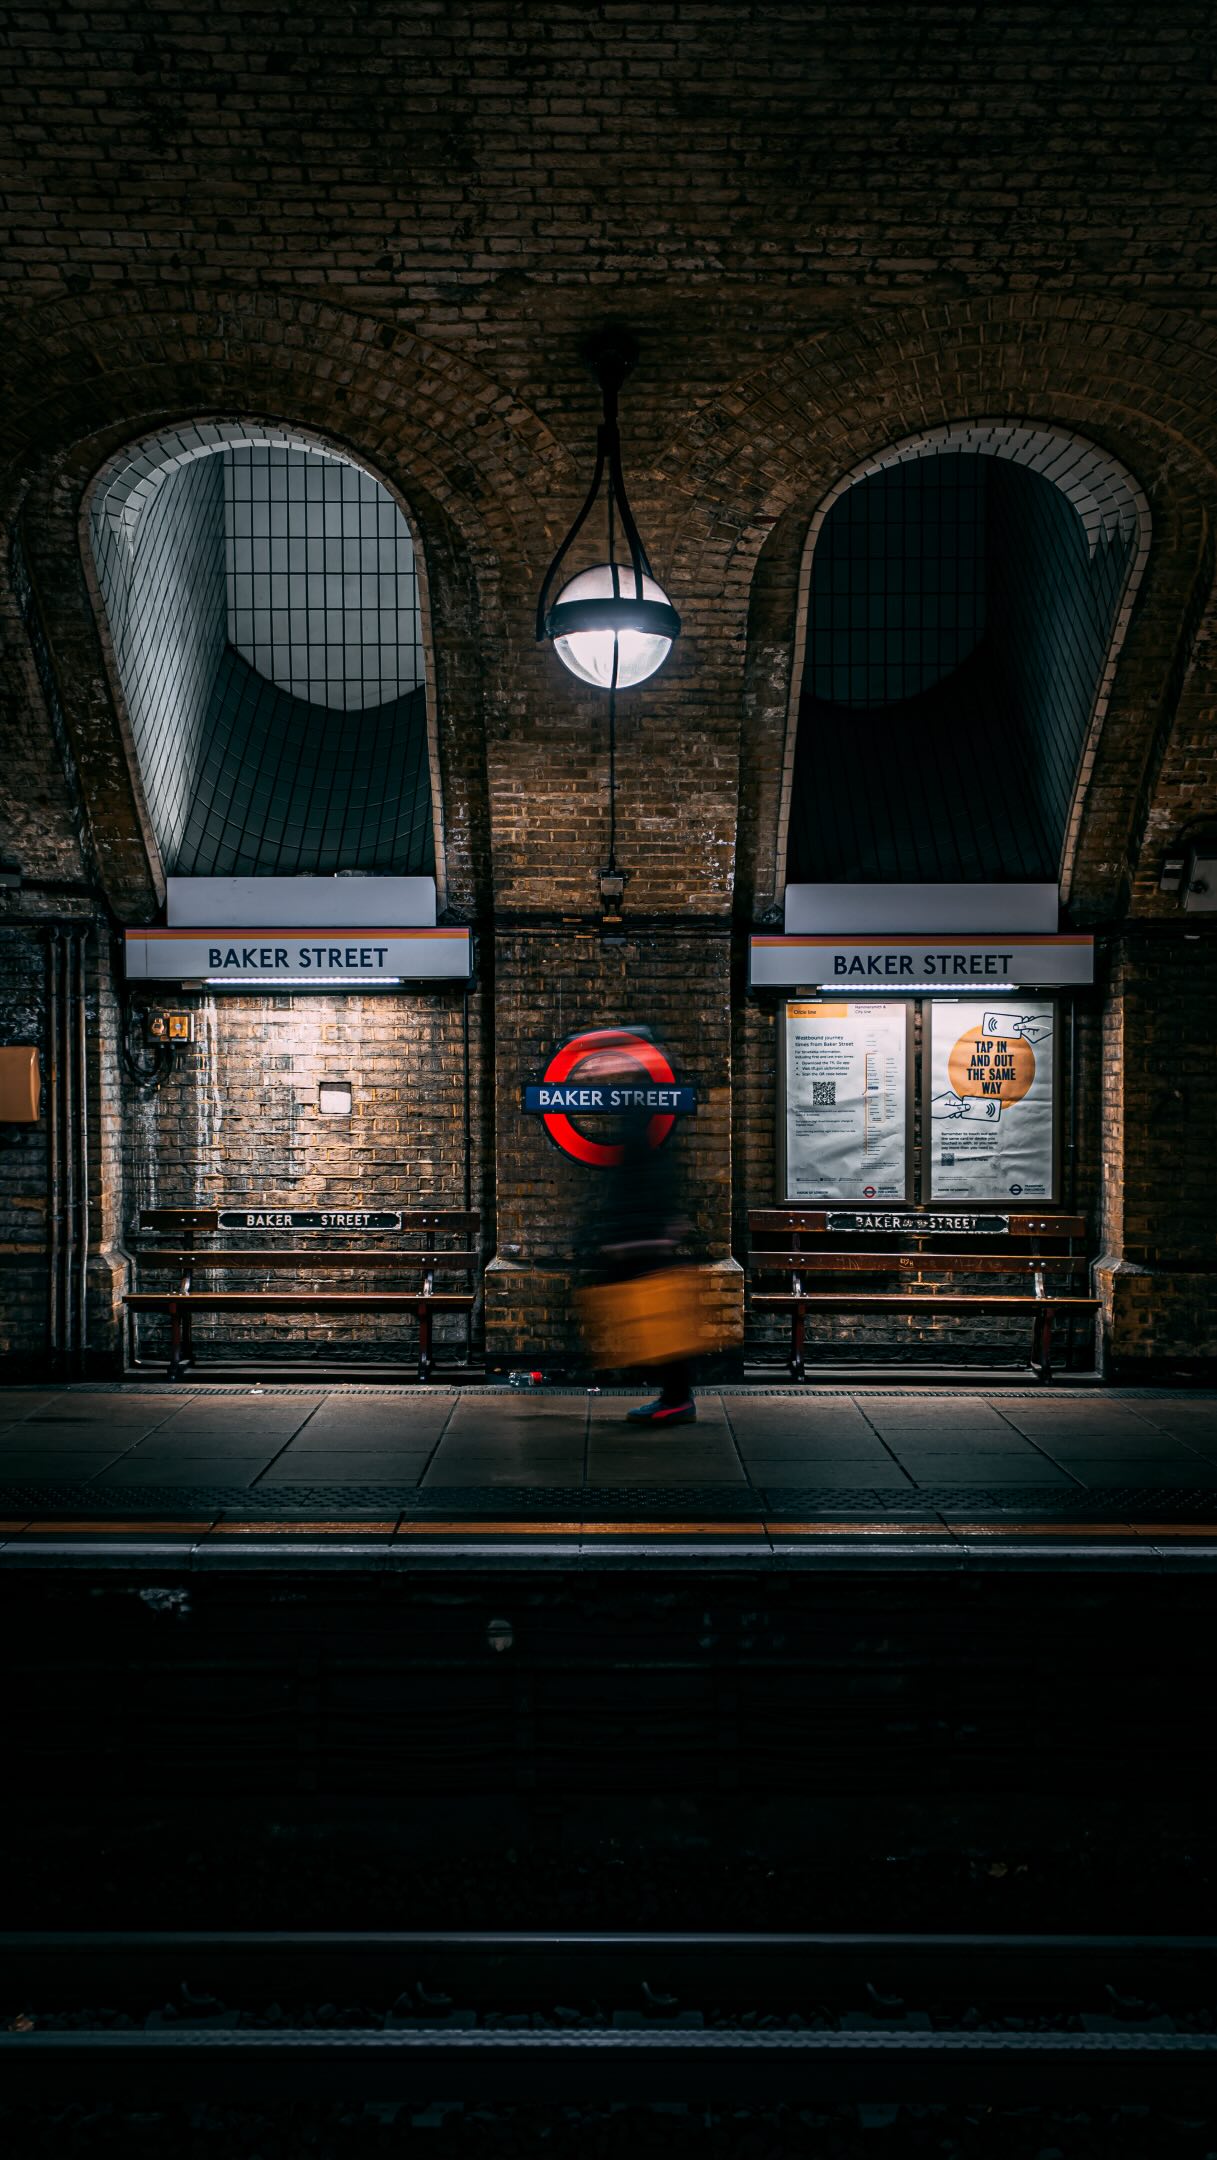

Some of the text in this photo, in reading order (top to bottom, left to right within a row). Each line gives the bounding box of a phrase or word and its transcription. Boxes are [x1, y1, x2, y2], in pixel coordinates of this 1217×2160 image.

[208, 948, 389, 968] BAKER STREET
[834, 955, 1013, 975] BAKER STREET
[975, 1041, 1007, 1053] TAP IN
[971, 1055, 1014, 1067] AND OUT
[966, 1068, 1016, 1080] THE SAME
[982, 1082, 1002, 1094] WAY
[539, 1090, 681, 1106] BAKER STREET
[246, 1215, 370, 1226] BAKER STREET
[855, 1216, 901, 1229] BAKER
[929, 1217, 977, 1230] STREET
